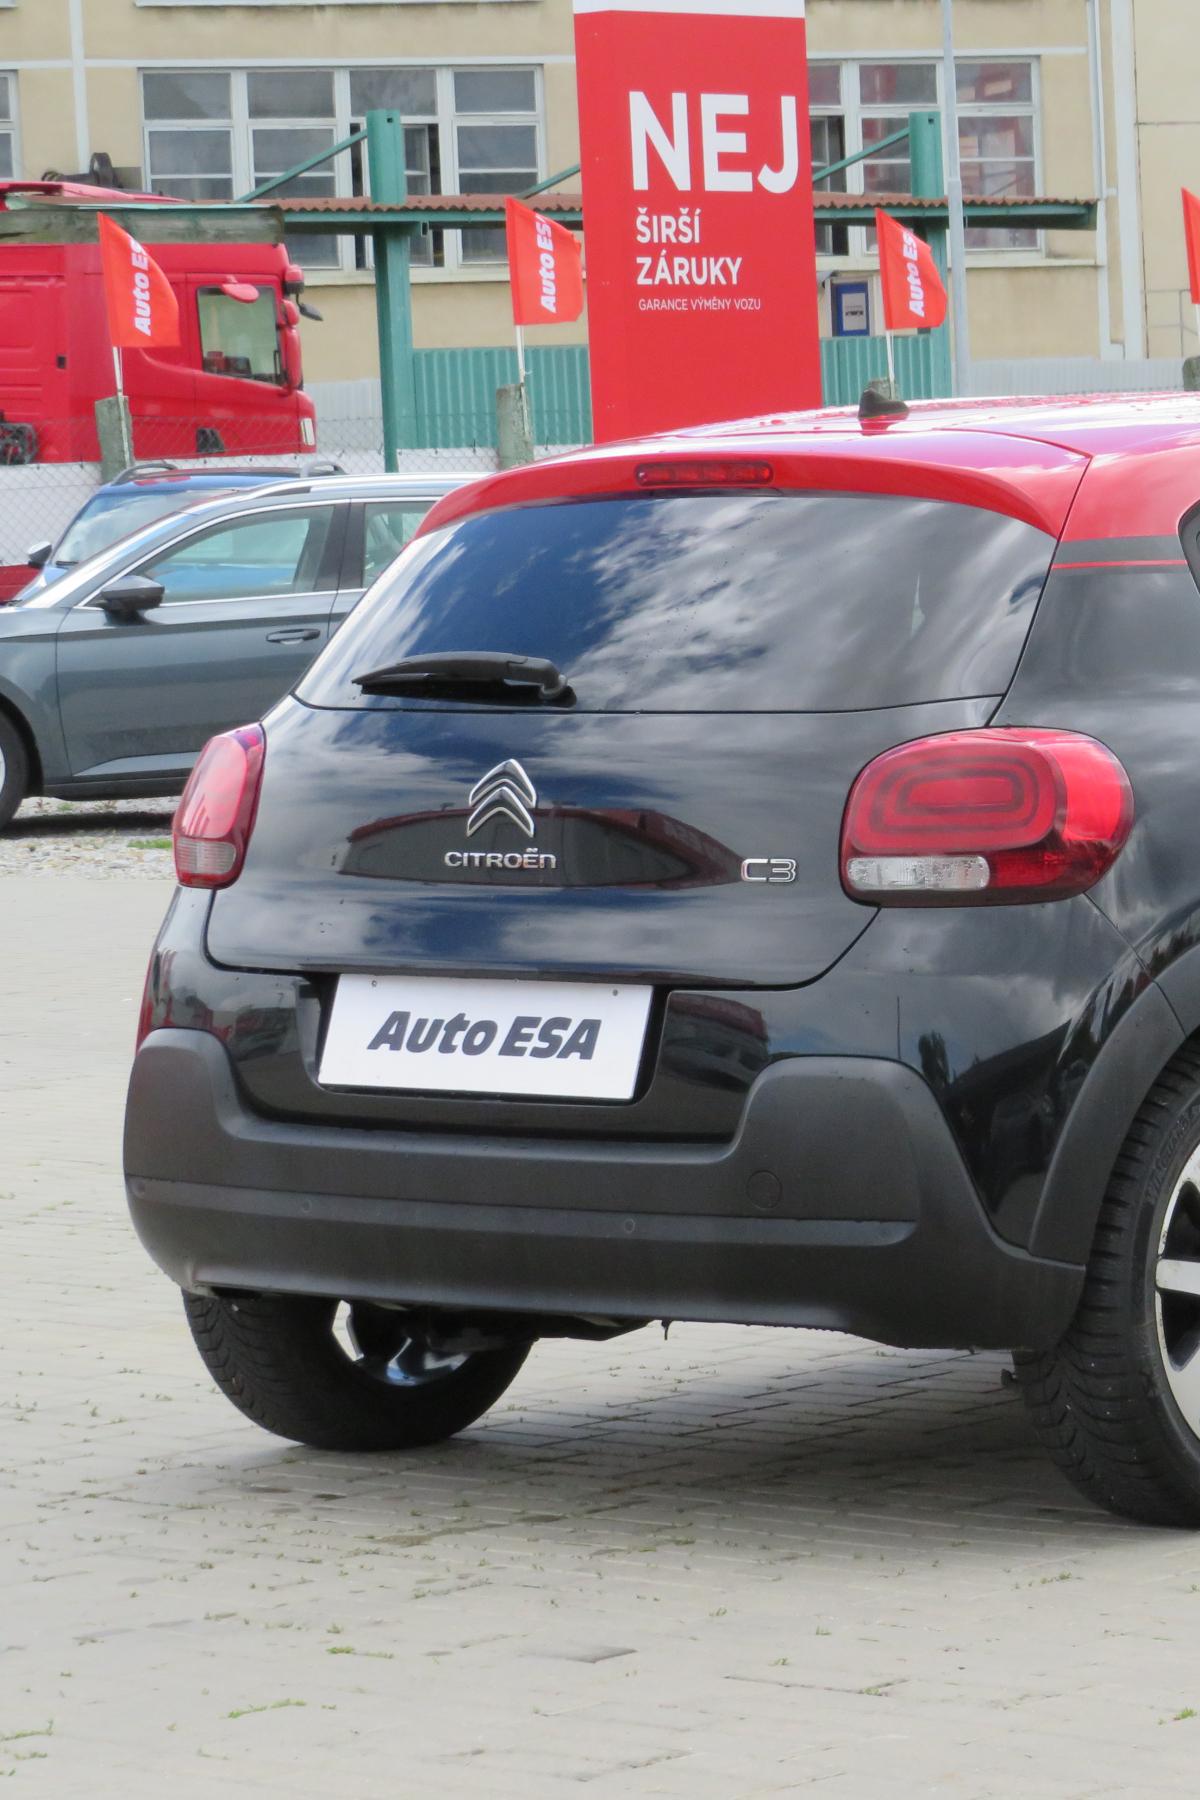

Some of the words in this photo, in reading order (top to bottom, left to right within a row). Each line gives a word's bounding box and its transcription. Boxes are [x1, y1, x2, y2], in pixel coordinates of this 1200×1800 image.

[629, 91, 799, 194] NEJ
[535, 213, 554, 252] ES
[635, 206, 701, 244] ŠIRŠÍ
[539, 253, 557, 313] Auto
[635, 249, 743, 286] ZÁRUKY
[907, 262, 925, 317] Auto
[133, 271, 152, 337] Auto
[638, 298, 689, 311] GARANCE
[690, 295, 731, 311] VÝMĚNY
[734, 298, 762, 310] VOZU
[740, 858, 797, 883] C3
[367, 1010, 499, 1056] Auto
[498, 1015, 602, 1060] ESA
